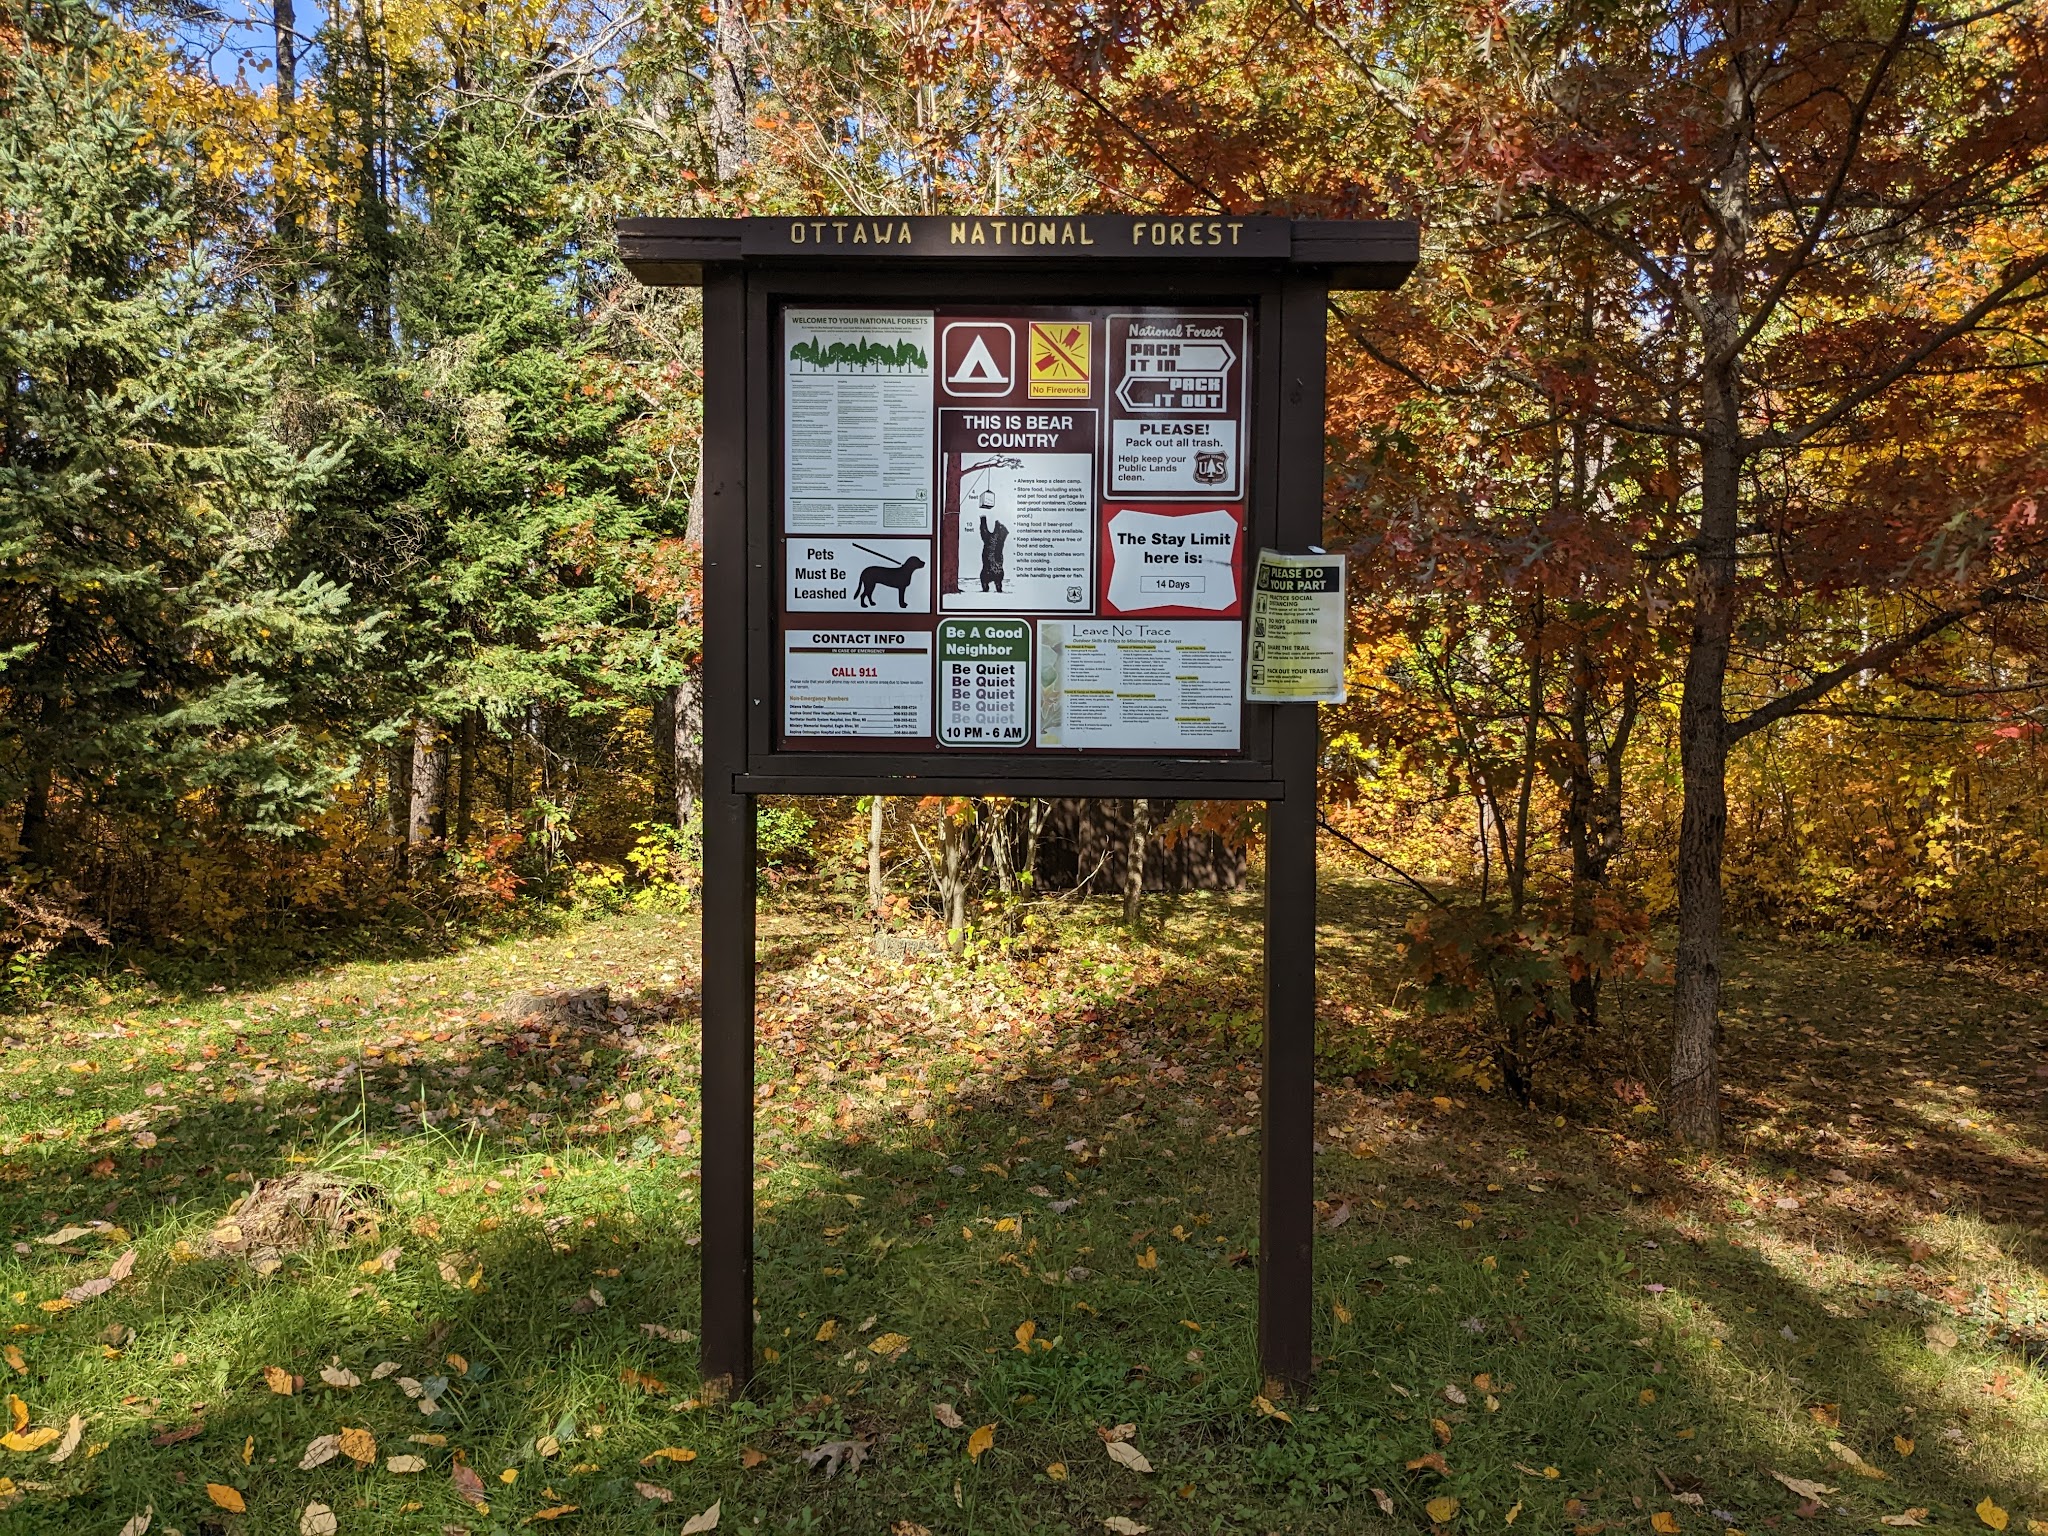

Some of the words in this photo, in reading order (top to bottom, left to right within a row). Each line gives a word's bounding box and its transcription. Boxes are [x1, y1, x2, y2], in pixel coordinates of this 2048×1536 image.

[790, 222, 912, 244] OTTAWA
[950, 221, 1094, 245] NATIONAL
[1132, 222, 1244, 245] FOREST
[1128, 323, 1182, 337] National
[1185, 324, 1224, 338] Forest
[1130, 344, 1181, 356] PACK
[1130, 359, 1150, 372] IT
[1032, 386, 1045, 394] No
[1046, 386, 1087, 394] Fireworks
[1170, 378, 1221, 391] PACK
[1154, 394, 1175, 407] IT
[1181, 394, 1221, 407] OUT
[962, 415, 1002, 430] THIS
[1005, 415, 1022, 430] IS
[1026, 416, 1073, 430] BEAR
[1139, 423, 1210, 435] PLEASE!
[977, 433, 1059, 448] COUNTRY
[1125, 438, 1152, 447] Pack
[1155, 438, 1173, 447] out
[1176, 438, 1189, 447] all
[1192, 438, 1223, 448] trash.
[1118, 455, 1139, 464] Help
[1141, 455, 1163, 464] keep
[1165, 456, 1187, 464] your
[1118, 464, 1147, 472] Public
[1149, 464, 1177, 472] Lands
[1118, 473, 1145, 481] clean.
[1117, 533, 1146, 545] The
[1151, 533, 1186, 547] Stay
[1191, 533, 1231, 545] Limit
[807, 548, 834, 560] Pets
[1144, 552, 1179, 564] here
[1184, 552, 1203, 564] is:
[795, 568, 827, 580] Must
[830, 568, 846, 580] Be
[1271, 567, 1302, 578] PLEASE
[1305, 568, 1324, 579] DO
[1156, 580, 1166, 588] 14
[1168, 580, 1190, 590] Days
[1270, 580, 1294, 591] YOUR
[1297, 580, 1327, 591] PART
[794, 587, 847, 599] Leashed
[946, 626, 966, 638] Be
[969, 627, 981, 638] A
[984, 627, 1023, 639] Good
[1072, 624, 1109, 637] Leave
[1112, 625, 1133, 637] No
[1135, 624, 1171, 637] Trace
[812, 634, 871, 644] CONTACT
[874, 634, 905, 644] INFO
[946, 643, 1012, 657] Neighbor
[831, 667, 857, 677] CALL
[859, 667, 878, 677] 911
[952, 664, 971, 675] Be
[976, 664, 1015, 675] Quiet
[952, 676, 971, 687] Be
[976, 676, 1015, 687] Quiet
[952, 689, 971, 700] Be
[976, 689, 1015, 700] Quiet
[952, 701, 971, 712] Be
[976, 701, 1015, 712] Quiet
[952, 713, 971, 724] Be
[976, 713, 1015, 724] Quiet
[946, 727, 961, 738] 10
[964, 727, 983, 738] PM
[992, 727, 1000, 738] 6
[1003, 727, 1022, 738] AM
